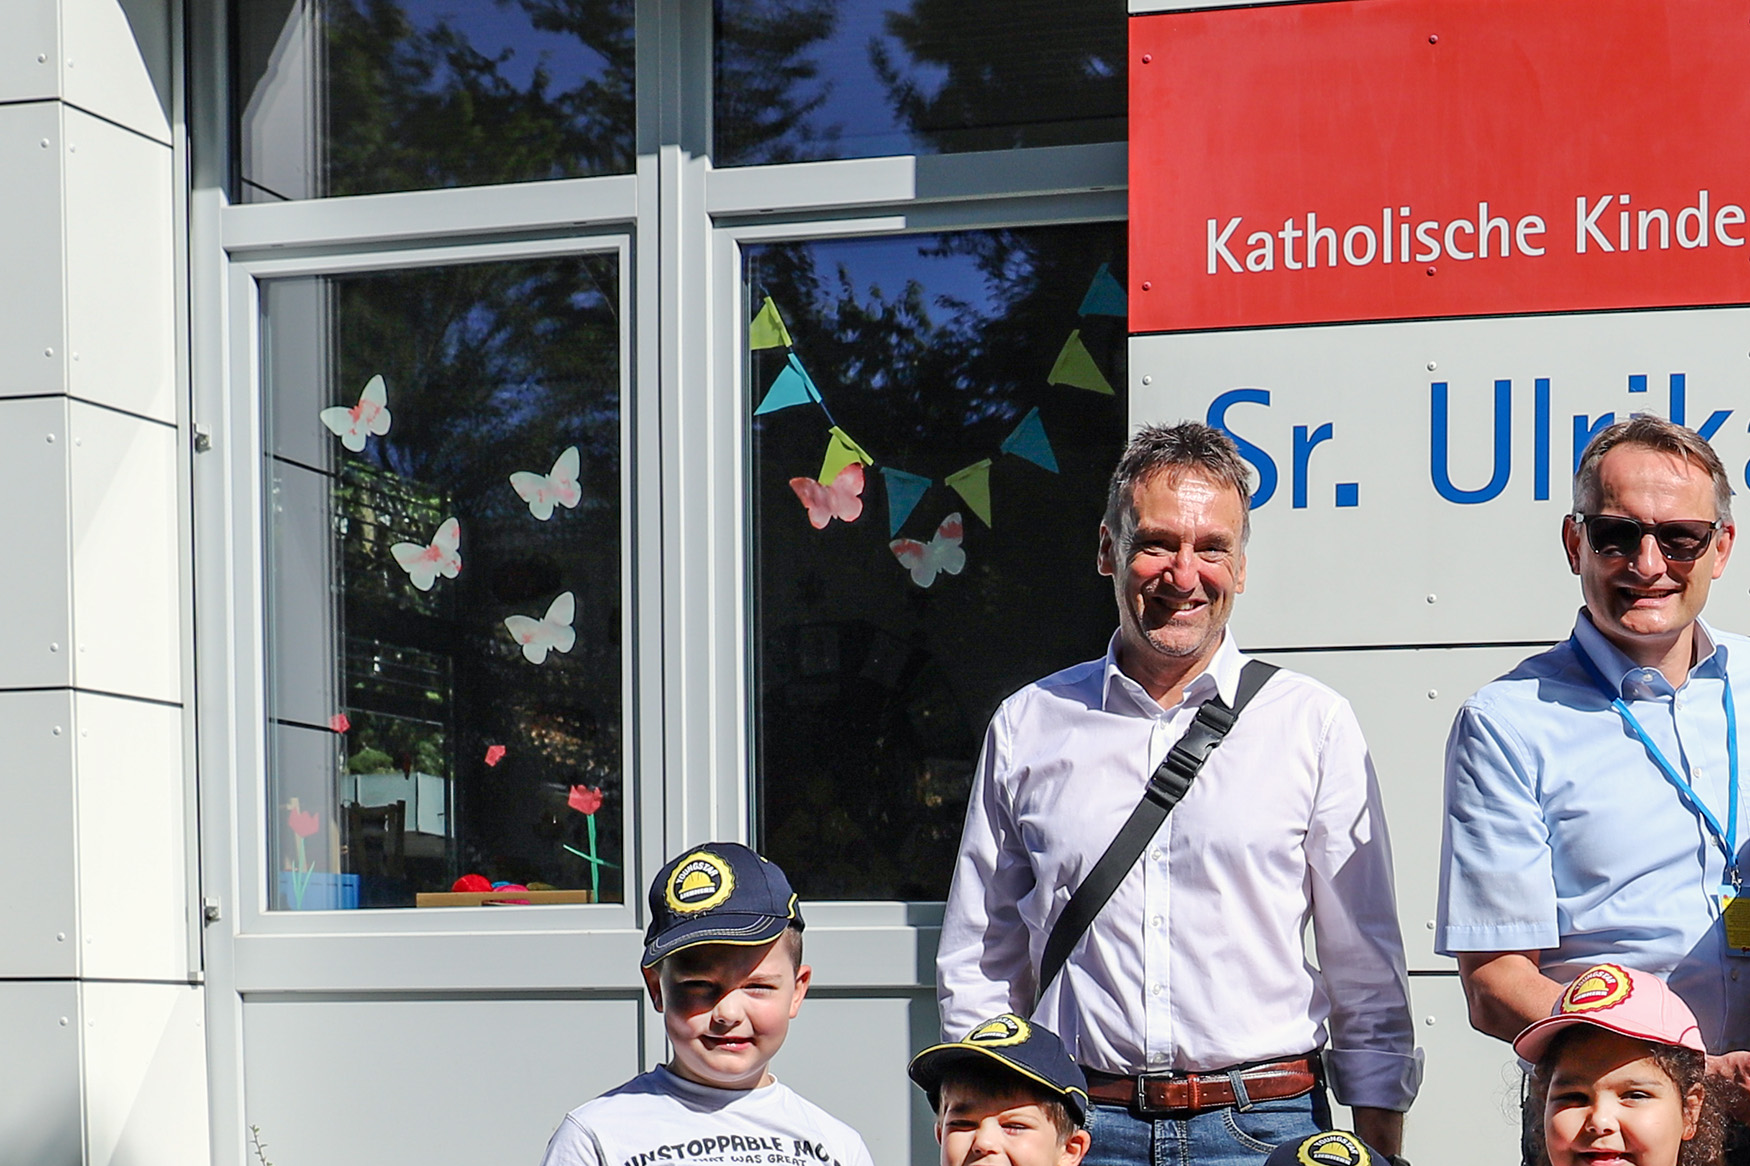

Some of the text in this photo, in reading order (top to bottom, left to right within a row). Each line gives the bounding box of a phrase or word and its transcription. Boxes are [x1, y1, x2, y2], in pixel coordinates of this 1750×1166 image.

[1207, 202, 1546, 275] Katholische
[1206, 388, 1359, 511] Sr.
[675, 861, 719, 884] YOUNGSTAR
[730, 1155, 763, 1165] WAS
